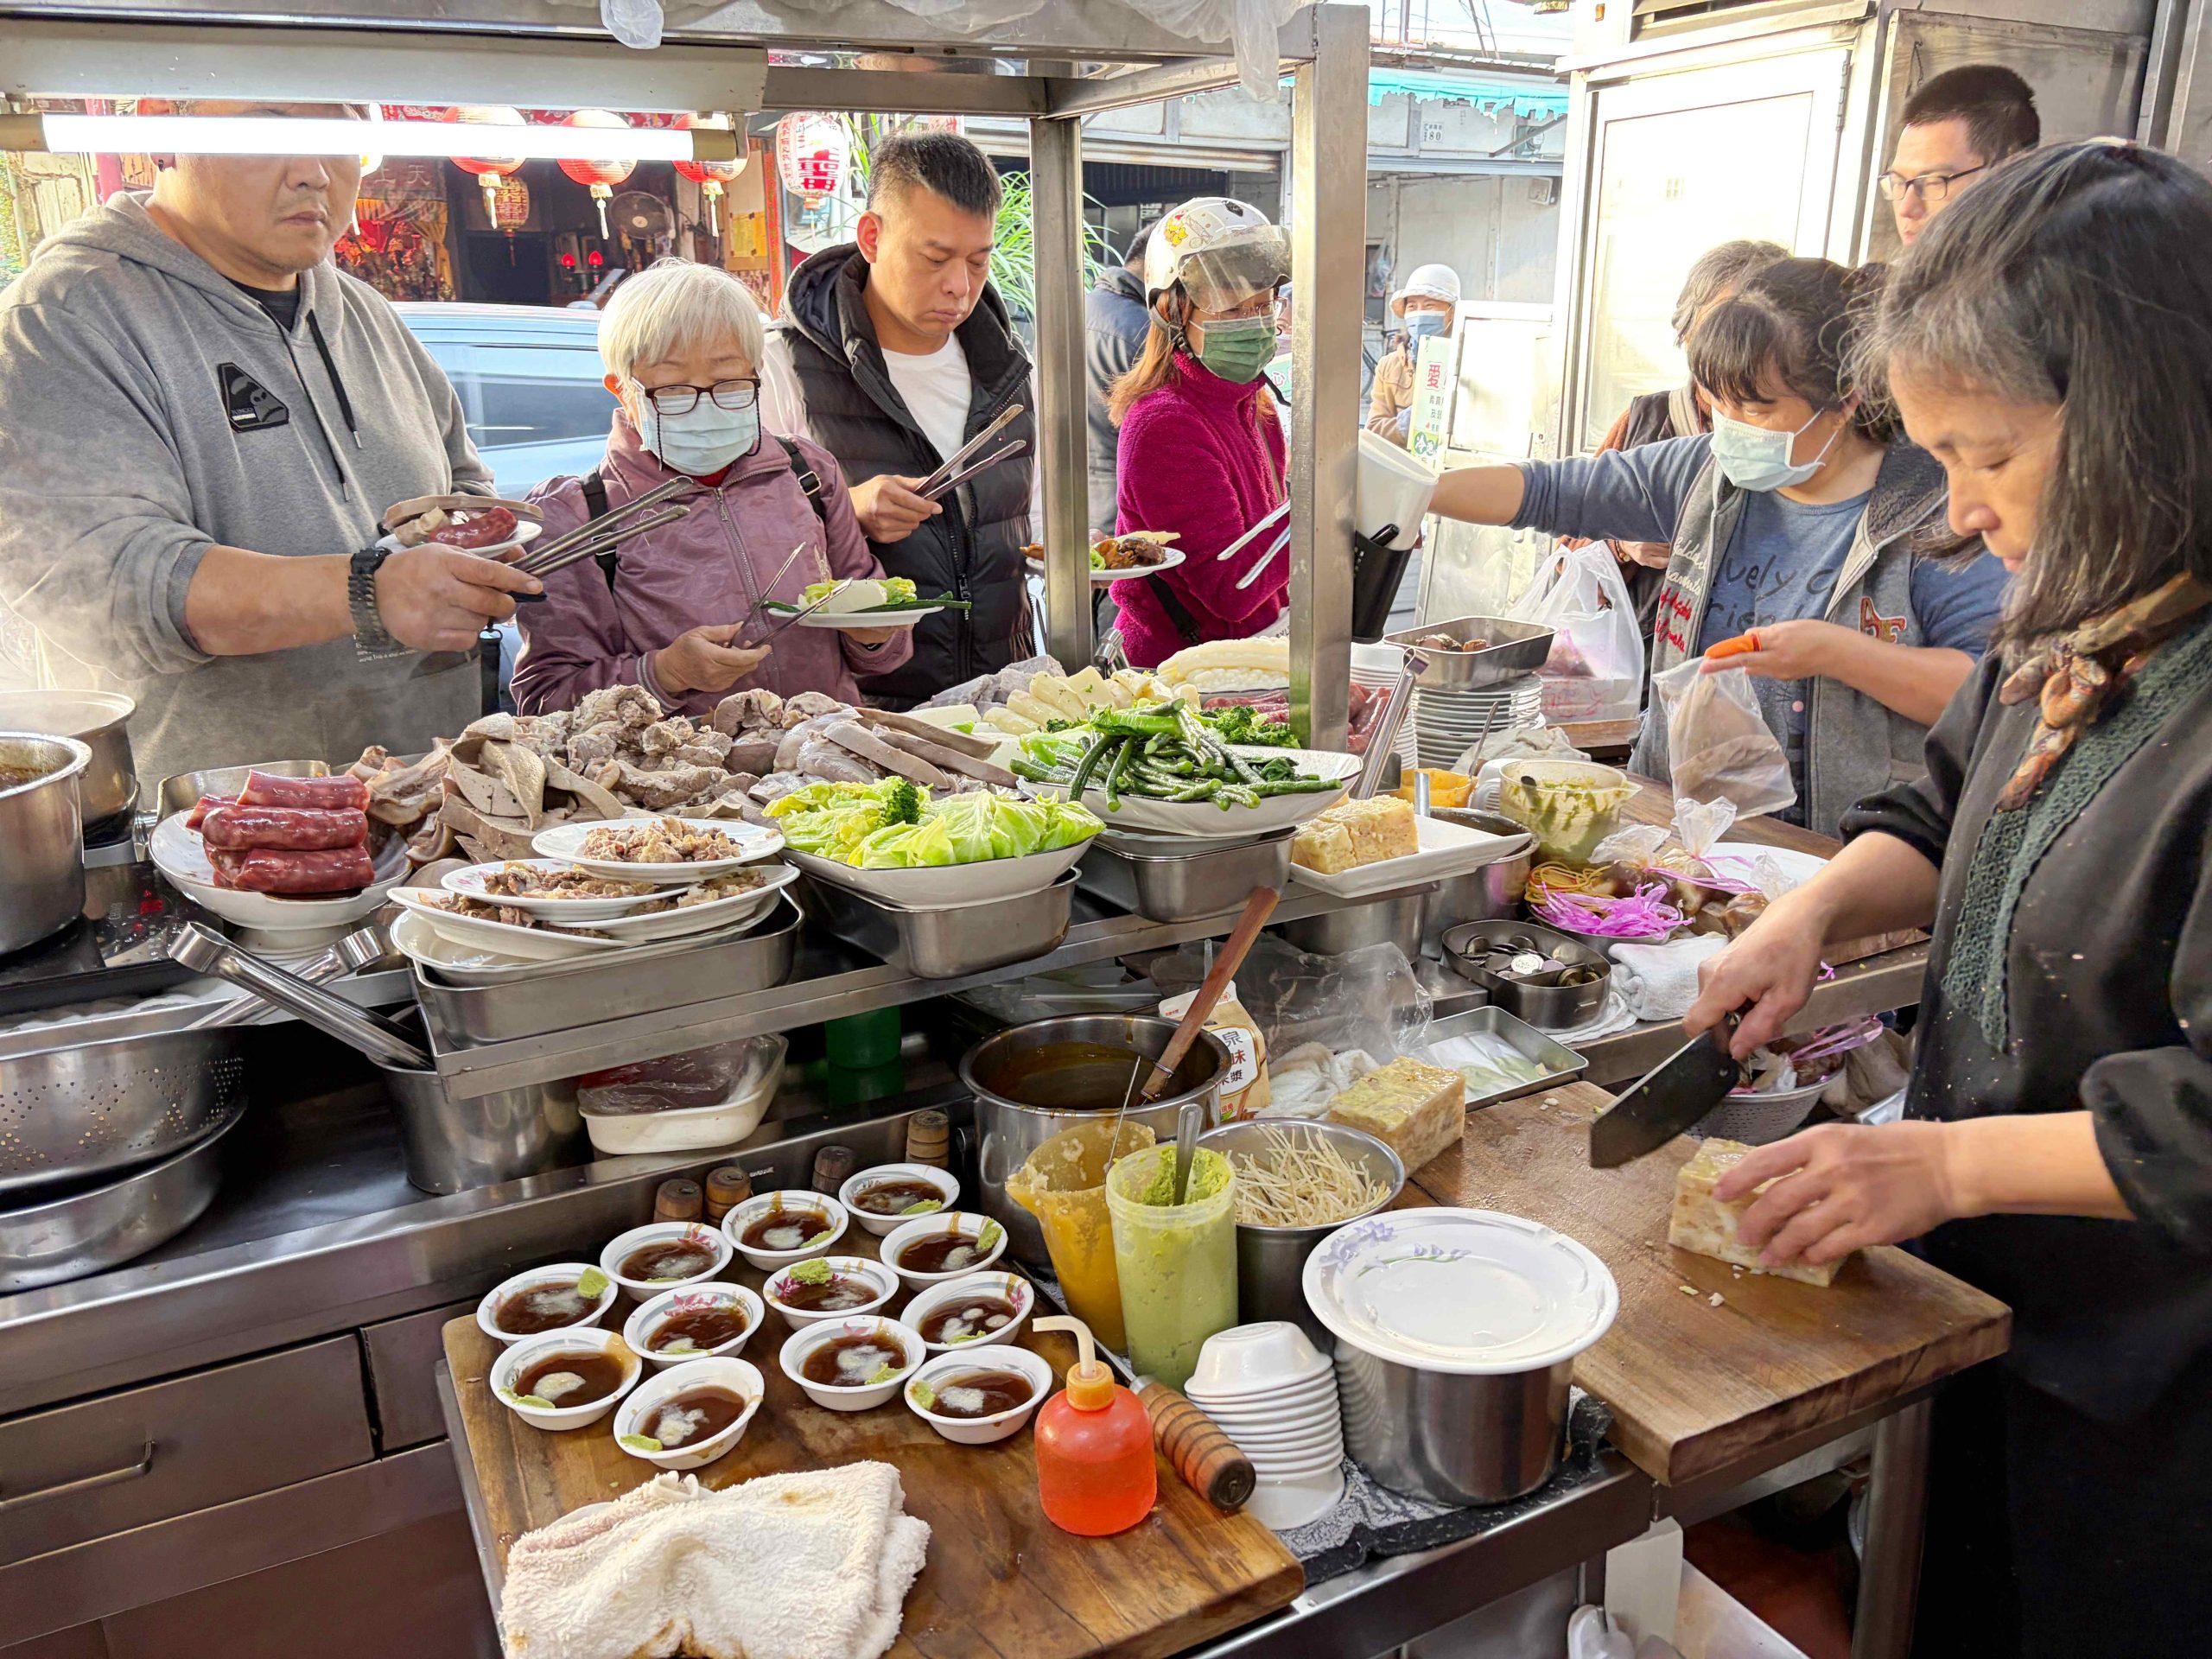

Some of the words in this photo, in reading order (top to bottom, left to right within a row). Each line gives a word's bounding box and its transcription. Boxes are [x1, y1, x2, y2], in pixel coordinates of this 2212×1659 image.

[1428, 131, 1441, 141] 80
[1222, 1030, 1243, 1048] 泉
[1230, 1049, 1246, 1065] 味
